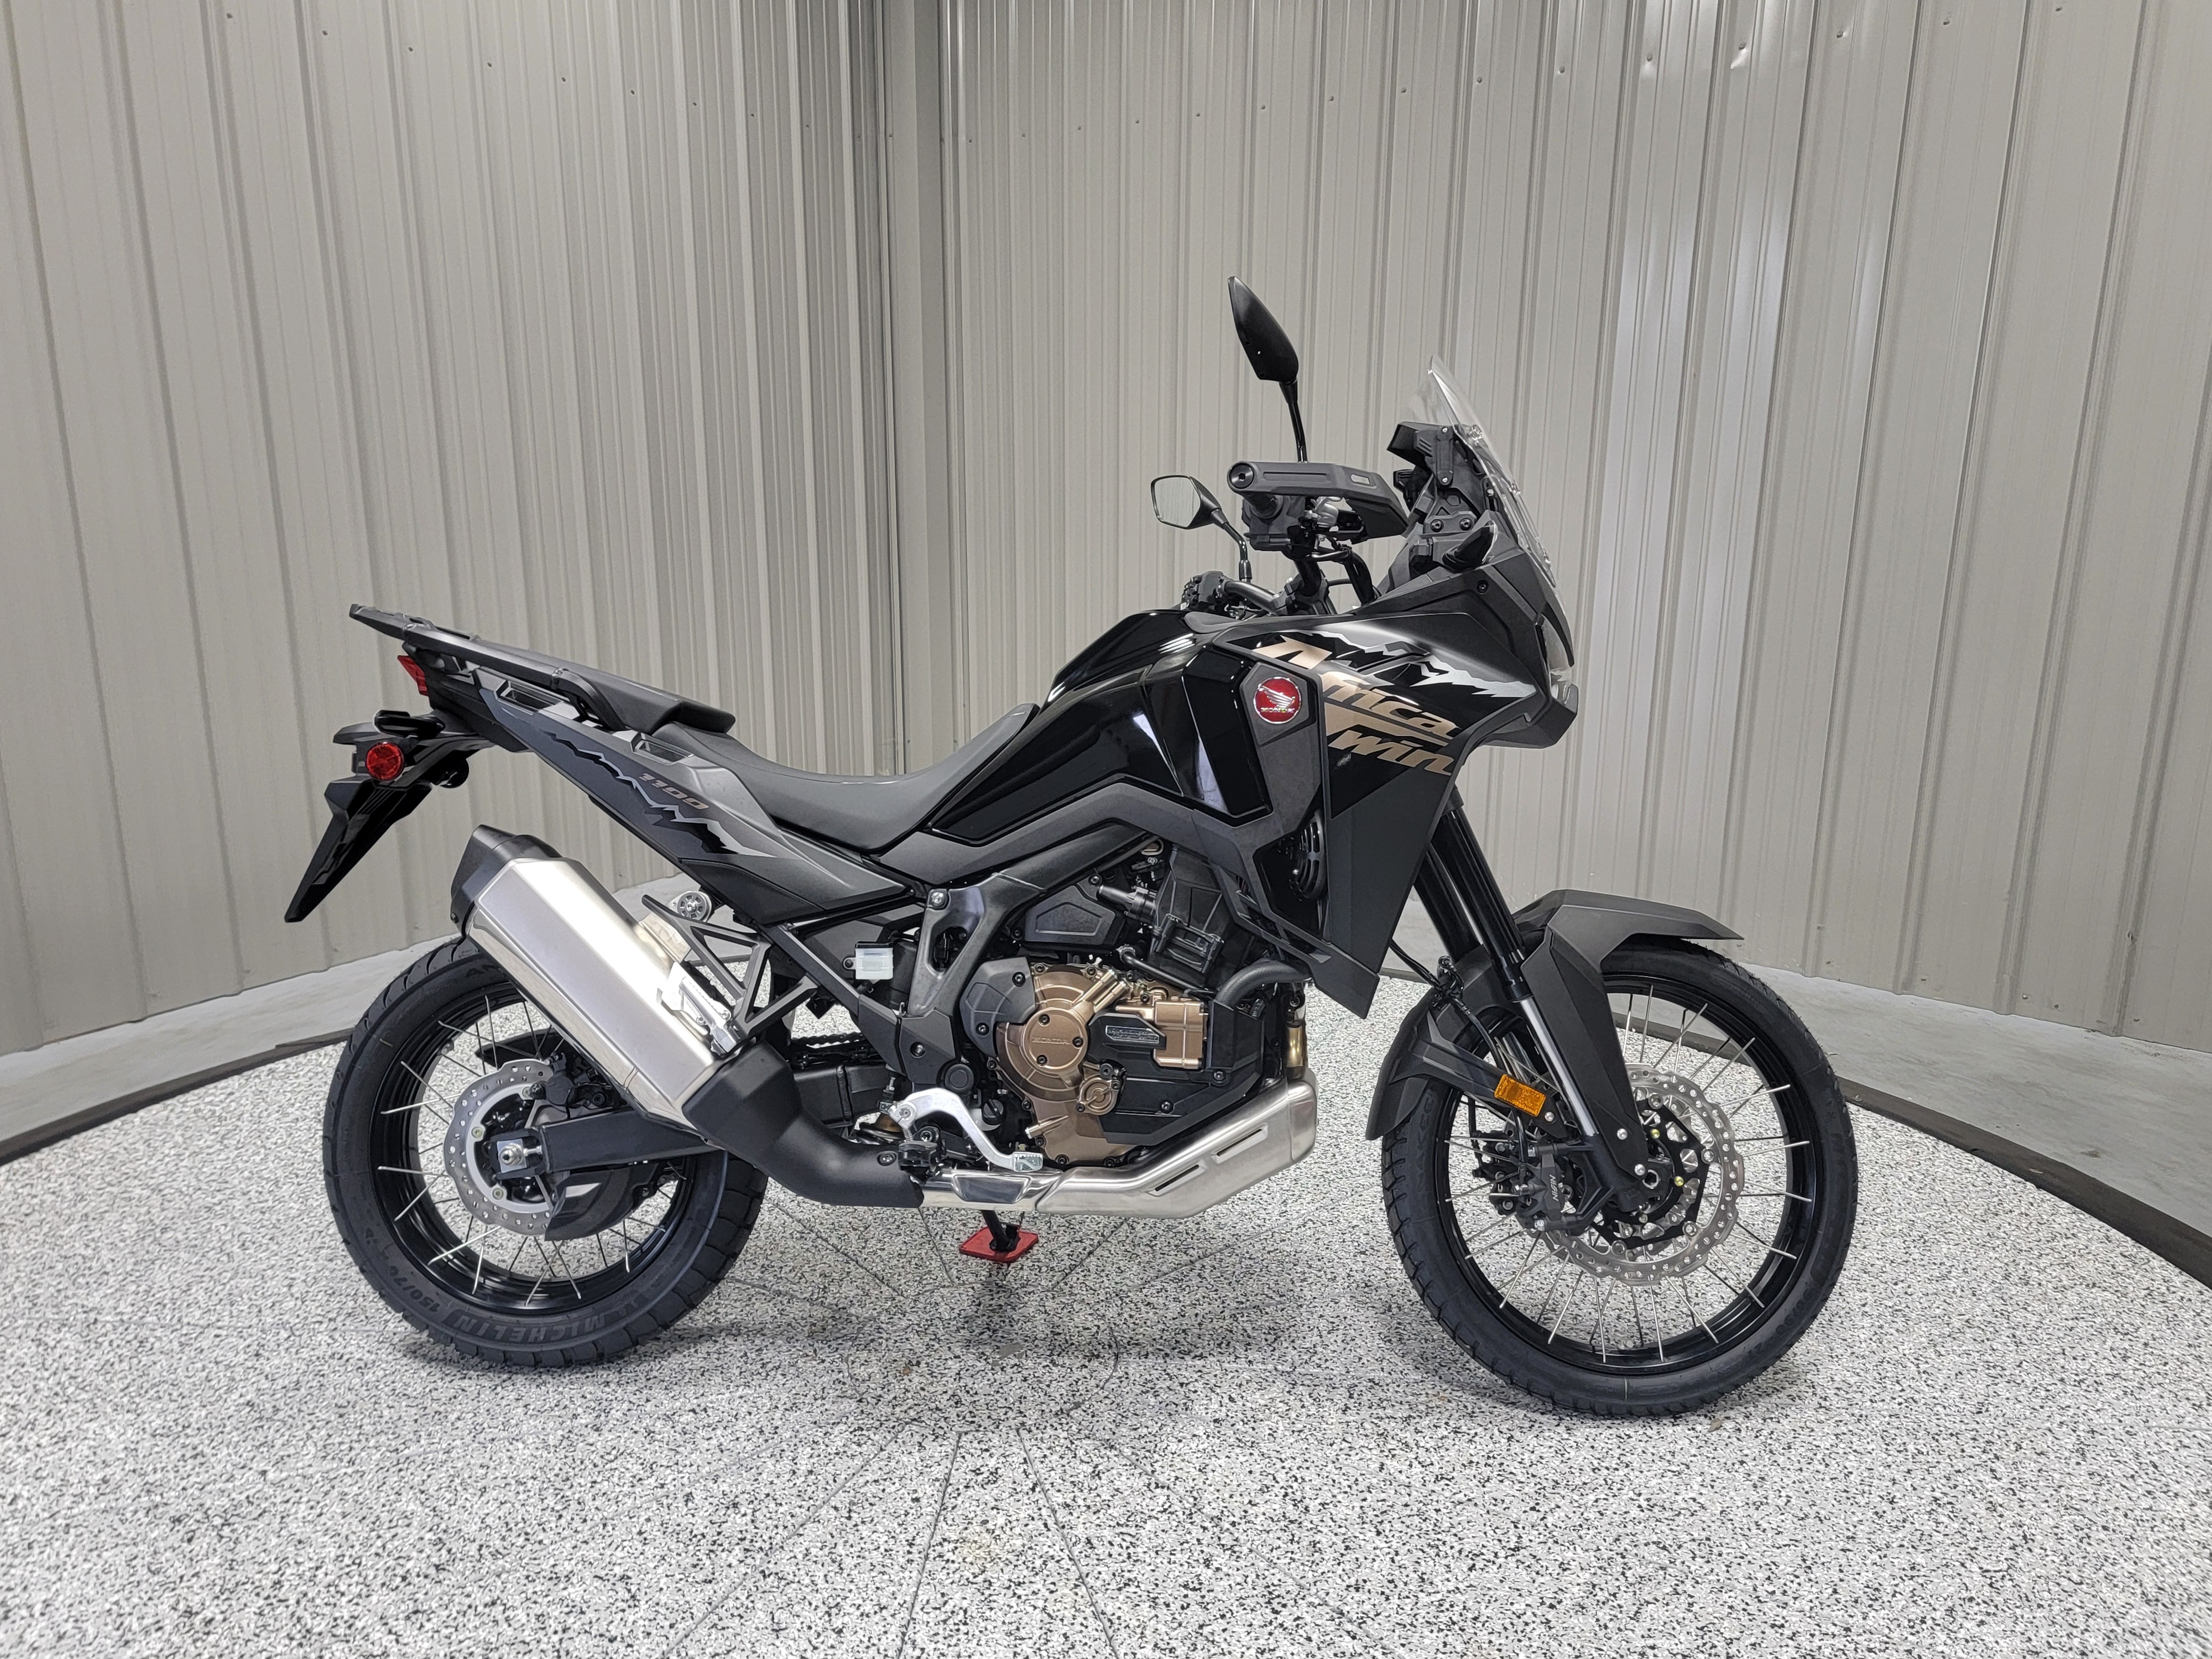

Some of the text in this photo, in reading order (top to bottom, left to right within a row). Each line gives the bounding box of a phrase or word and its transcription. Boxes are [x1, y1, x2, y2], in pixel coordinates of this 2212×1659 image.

[638, 773, 709, 810] 1100
[1032, 1037, 1071, 1045] HONDA
[458, 1312, 608, 1344] MICHELIN
